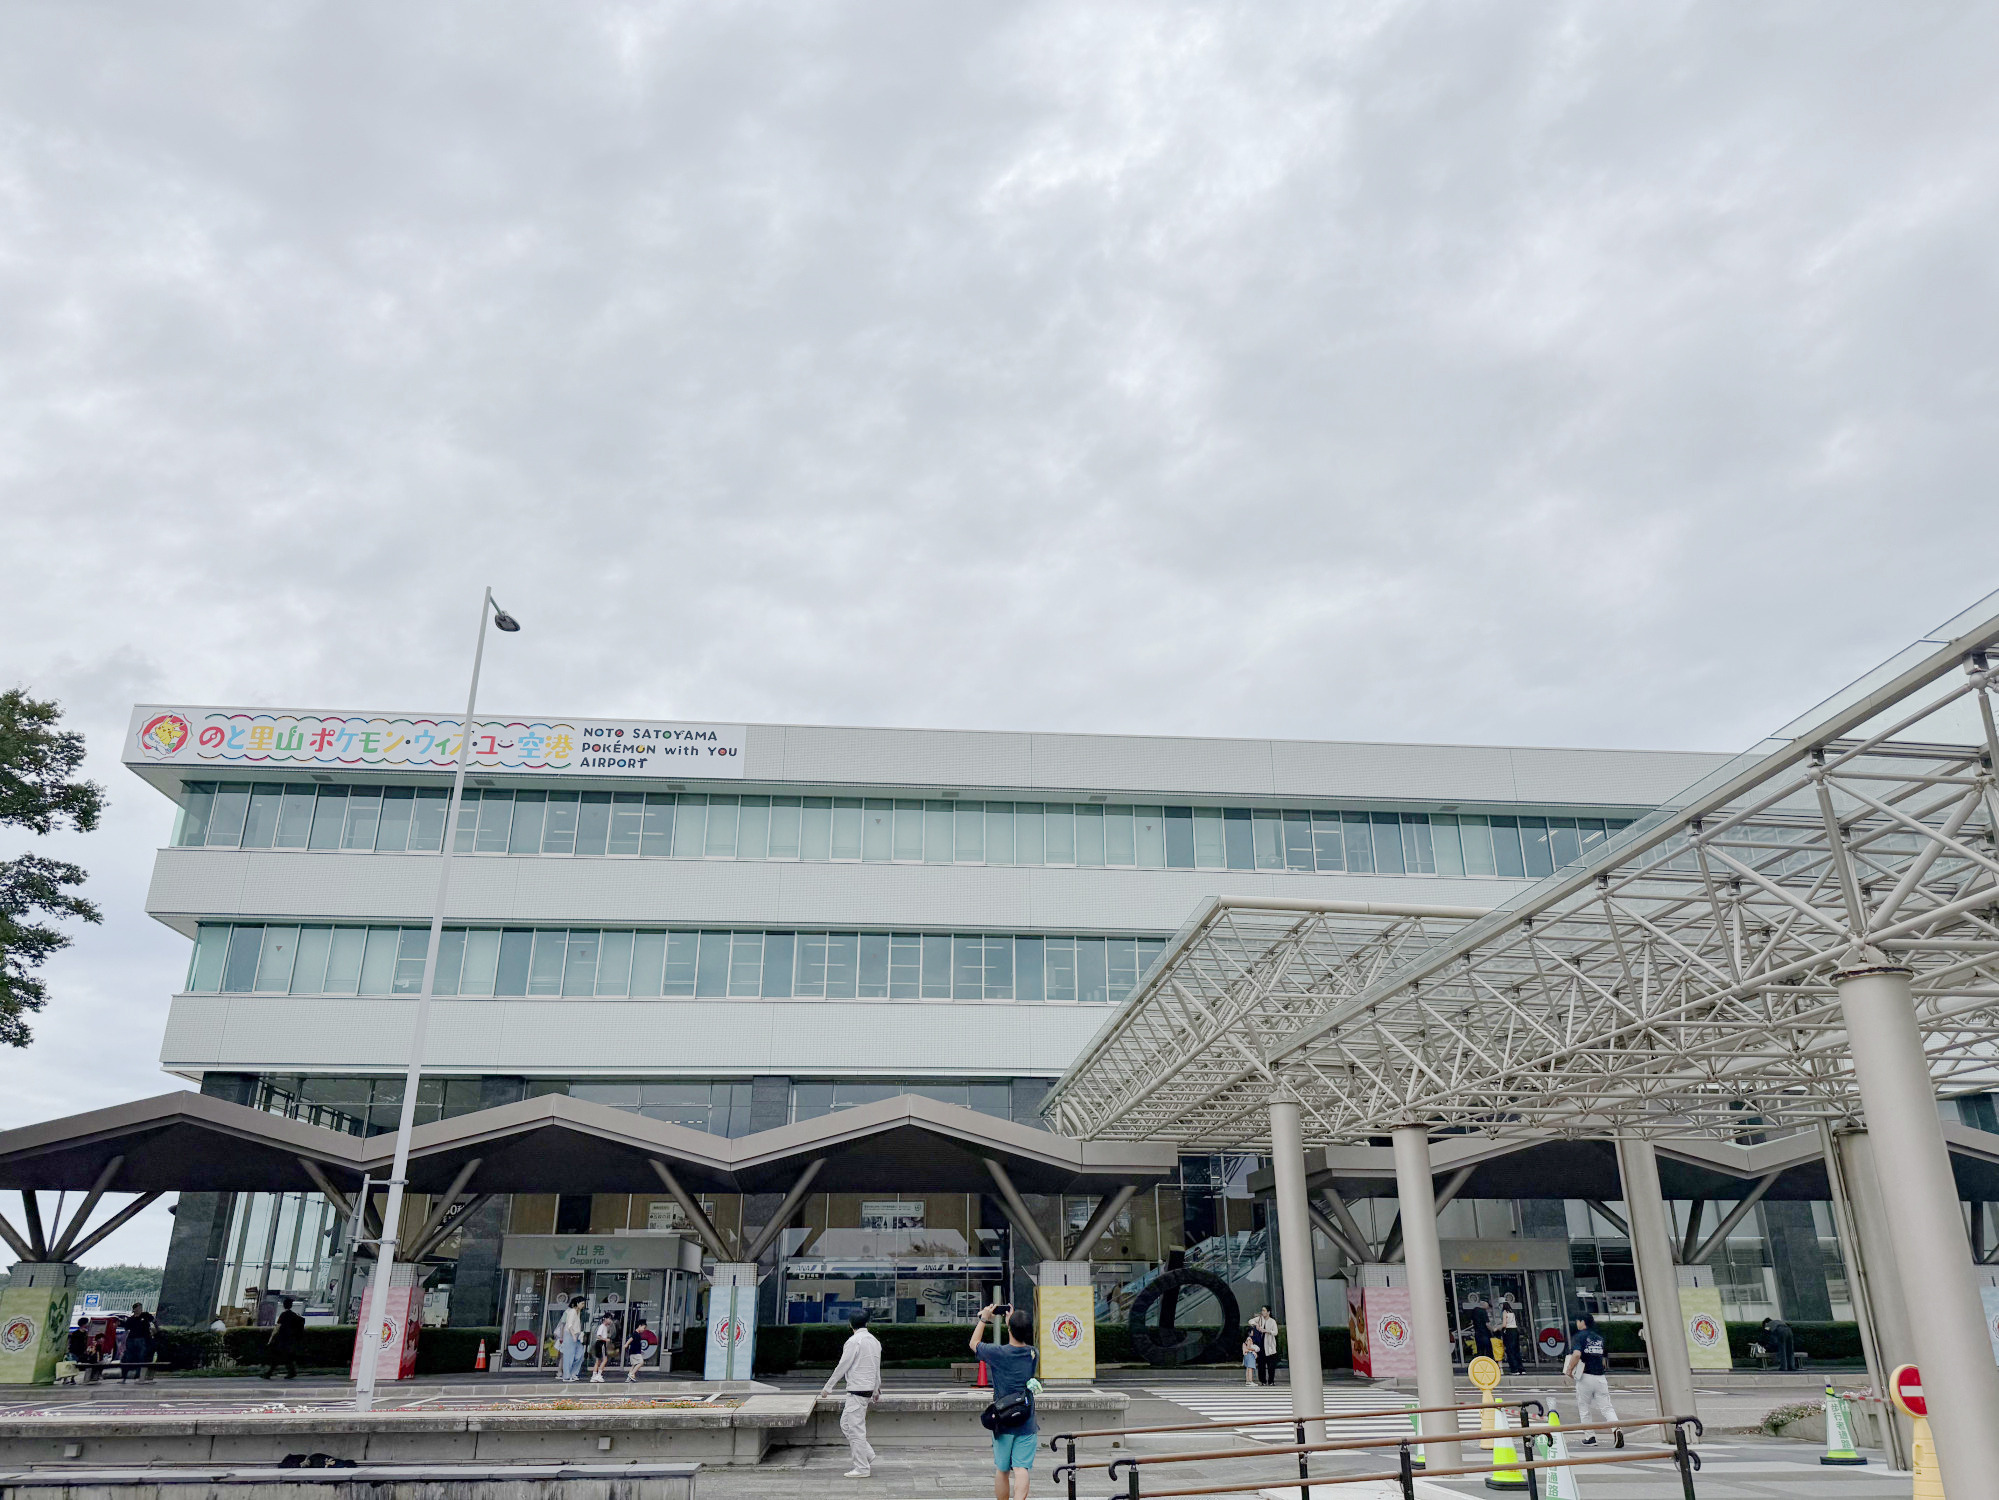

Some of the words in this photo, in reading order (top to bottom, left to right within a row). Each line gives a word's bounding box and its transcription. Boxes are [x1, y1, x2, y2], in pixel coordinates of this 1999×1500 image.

[583, 727, 624, 738] NOTO
[632, 728, 717, 741] SATOYAMA
[582, 740, 656, 754] POKÉMON
[664, 745, 699, 756] with
[707, 746, 738, 757] YOU
[580, 757, 648, 769] AIRPORT
[576, 1244, 606, 1257] 出発
[569, 1256, 610, 1266] Departure
